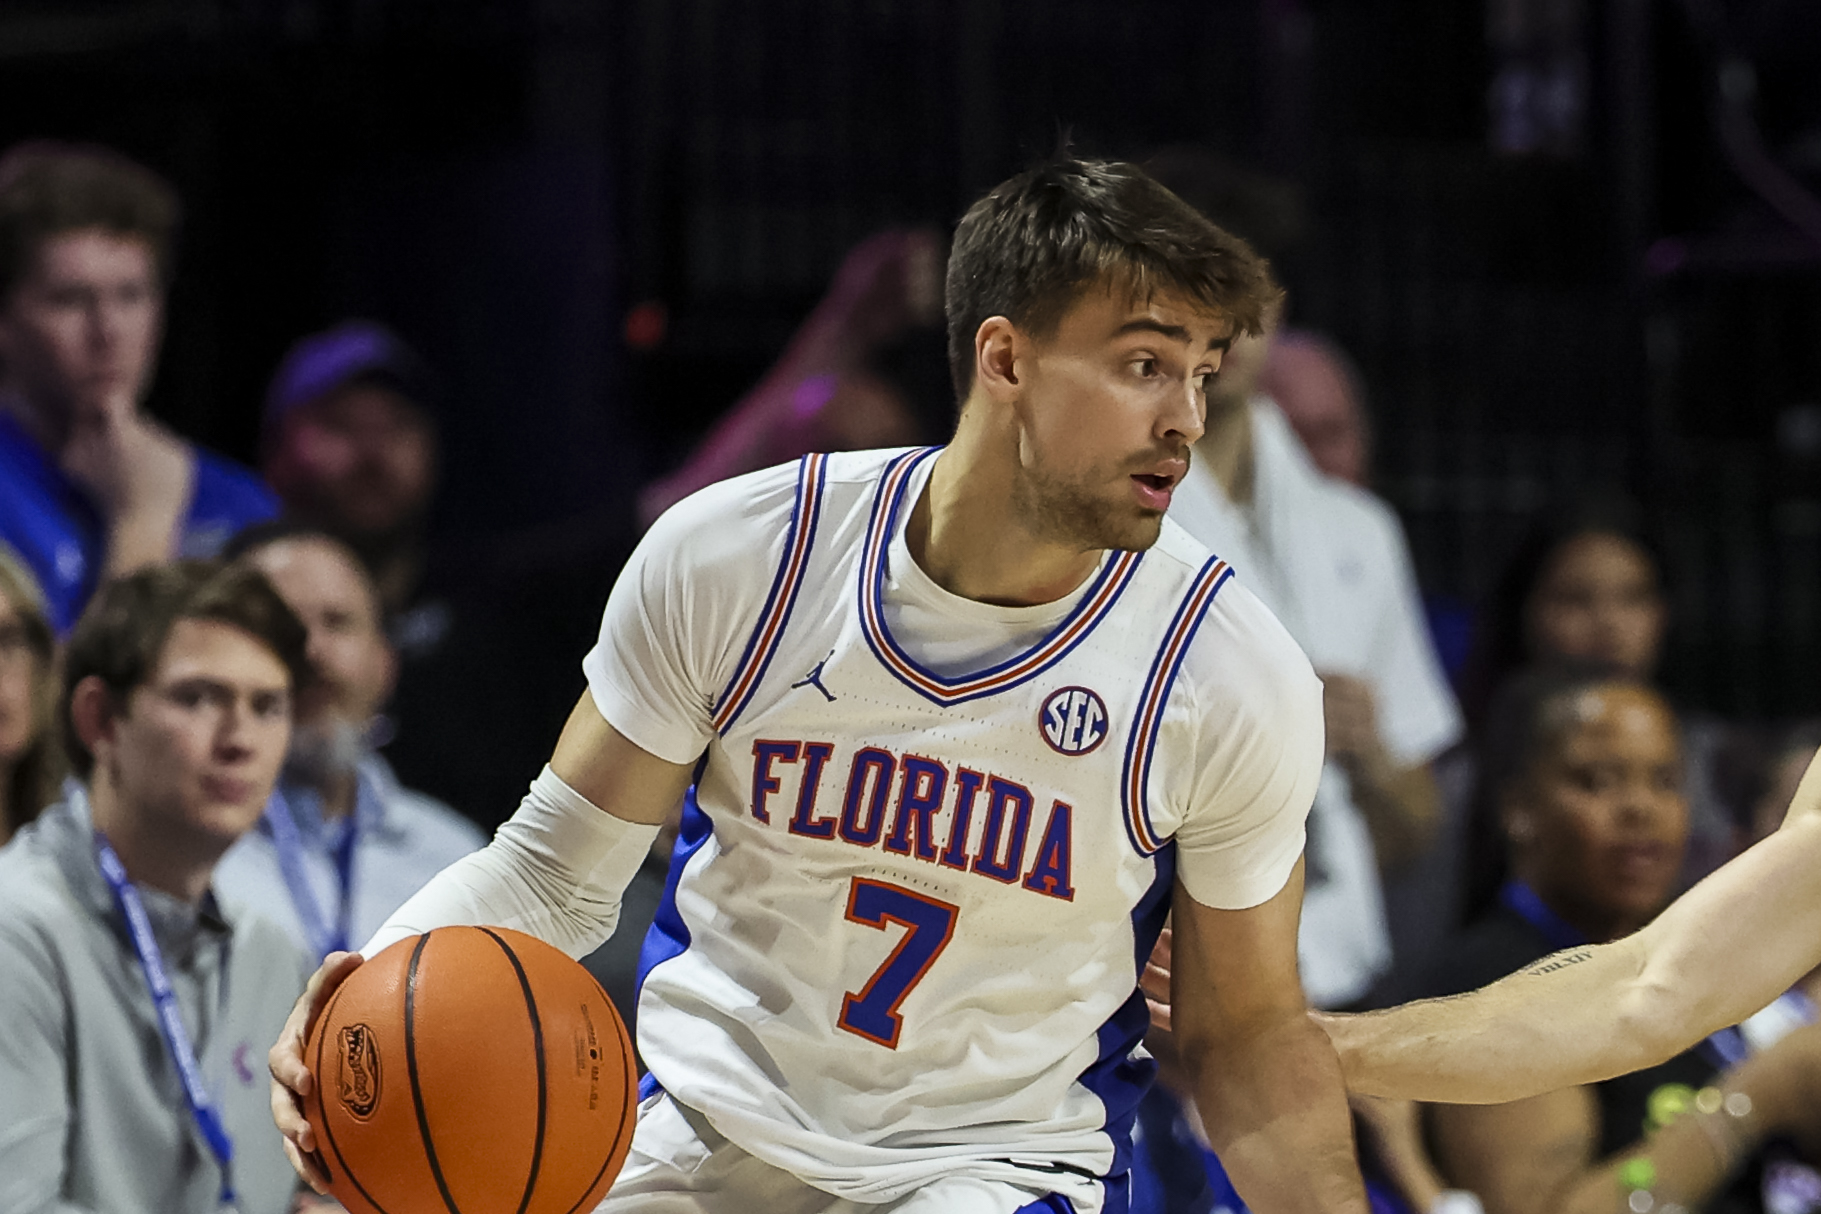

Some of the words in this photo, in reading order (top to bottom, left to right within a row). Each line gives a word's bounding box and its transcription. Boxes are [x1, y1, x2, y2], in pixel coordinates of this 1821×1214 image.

[1044, 690, 1104, 751] SEC
[750, 739, 1076, 902] FLORIDA
[836, 876, 960, 1050] 7
